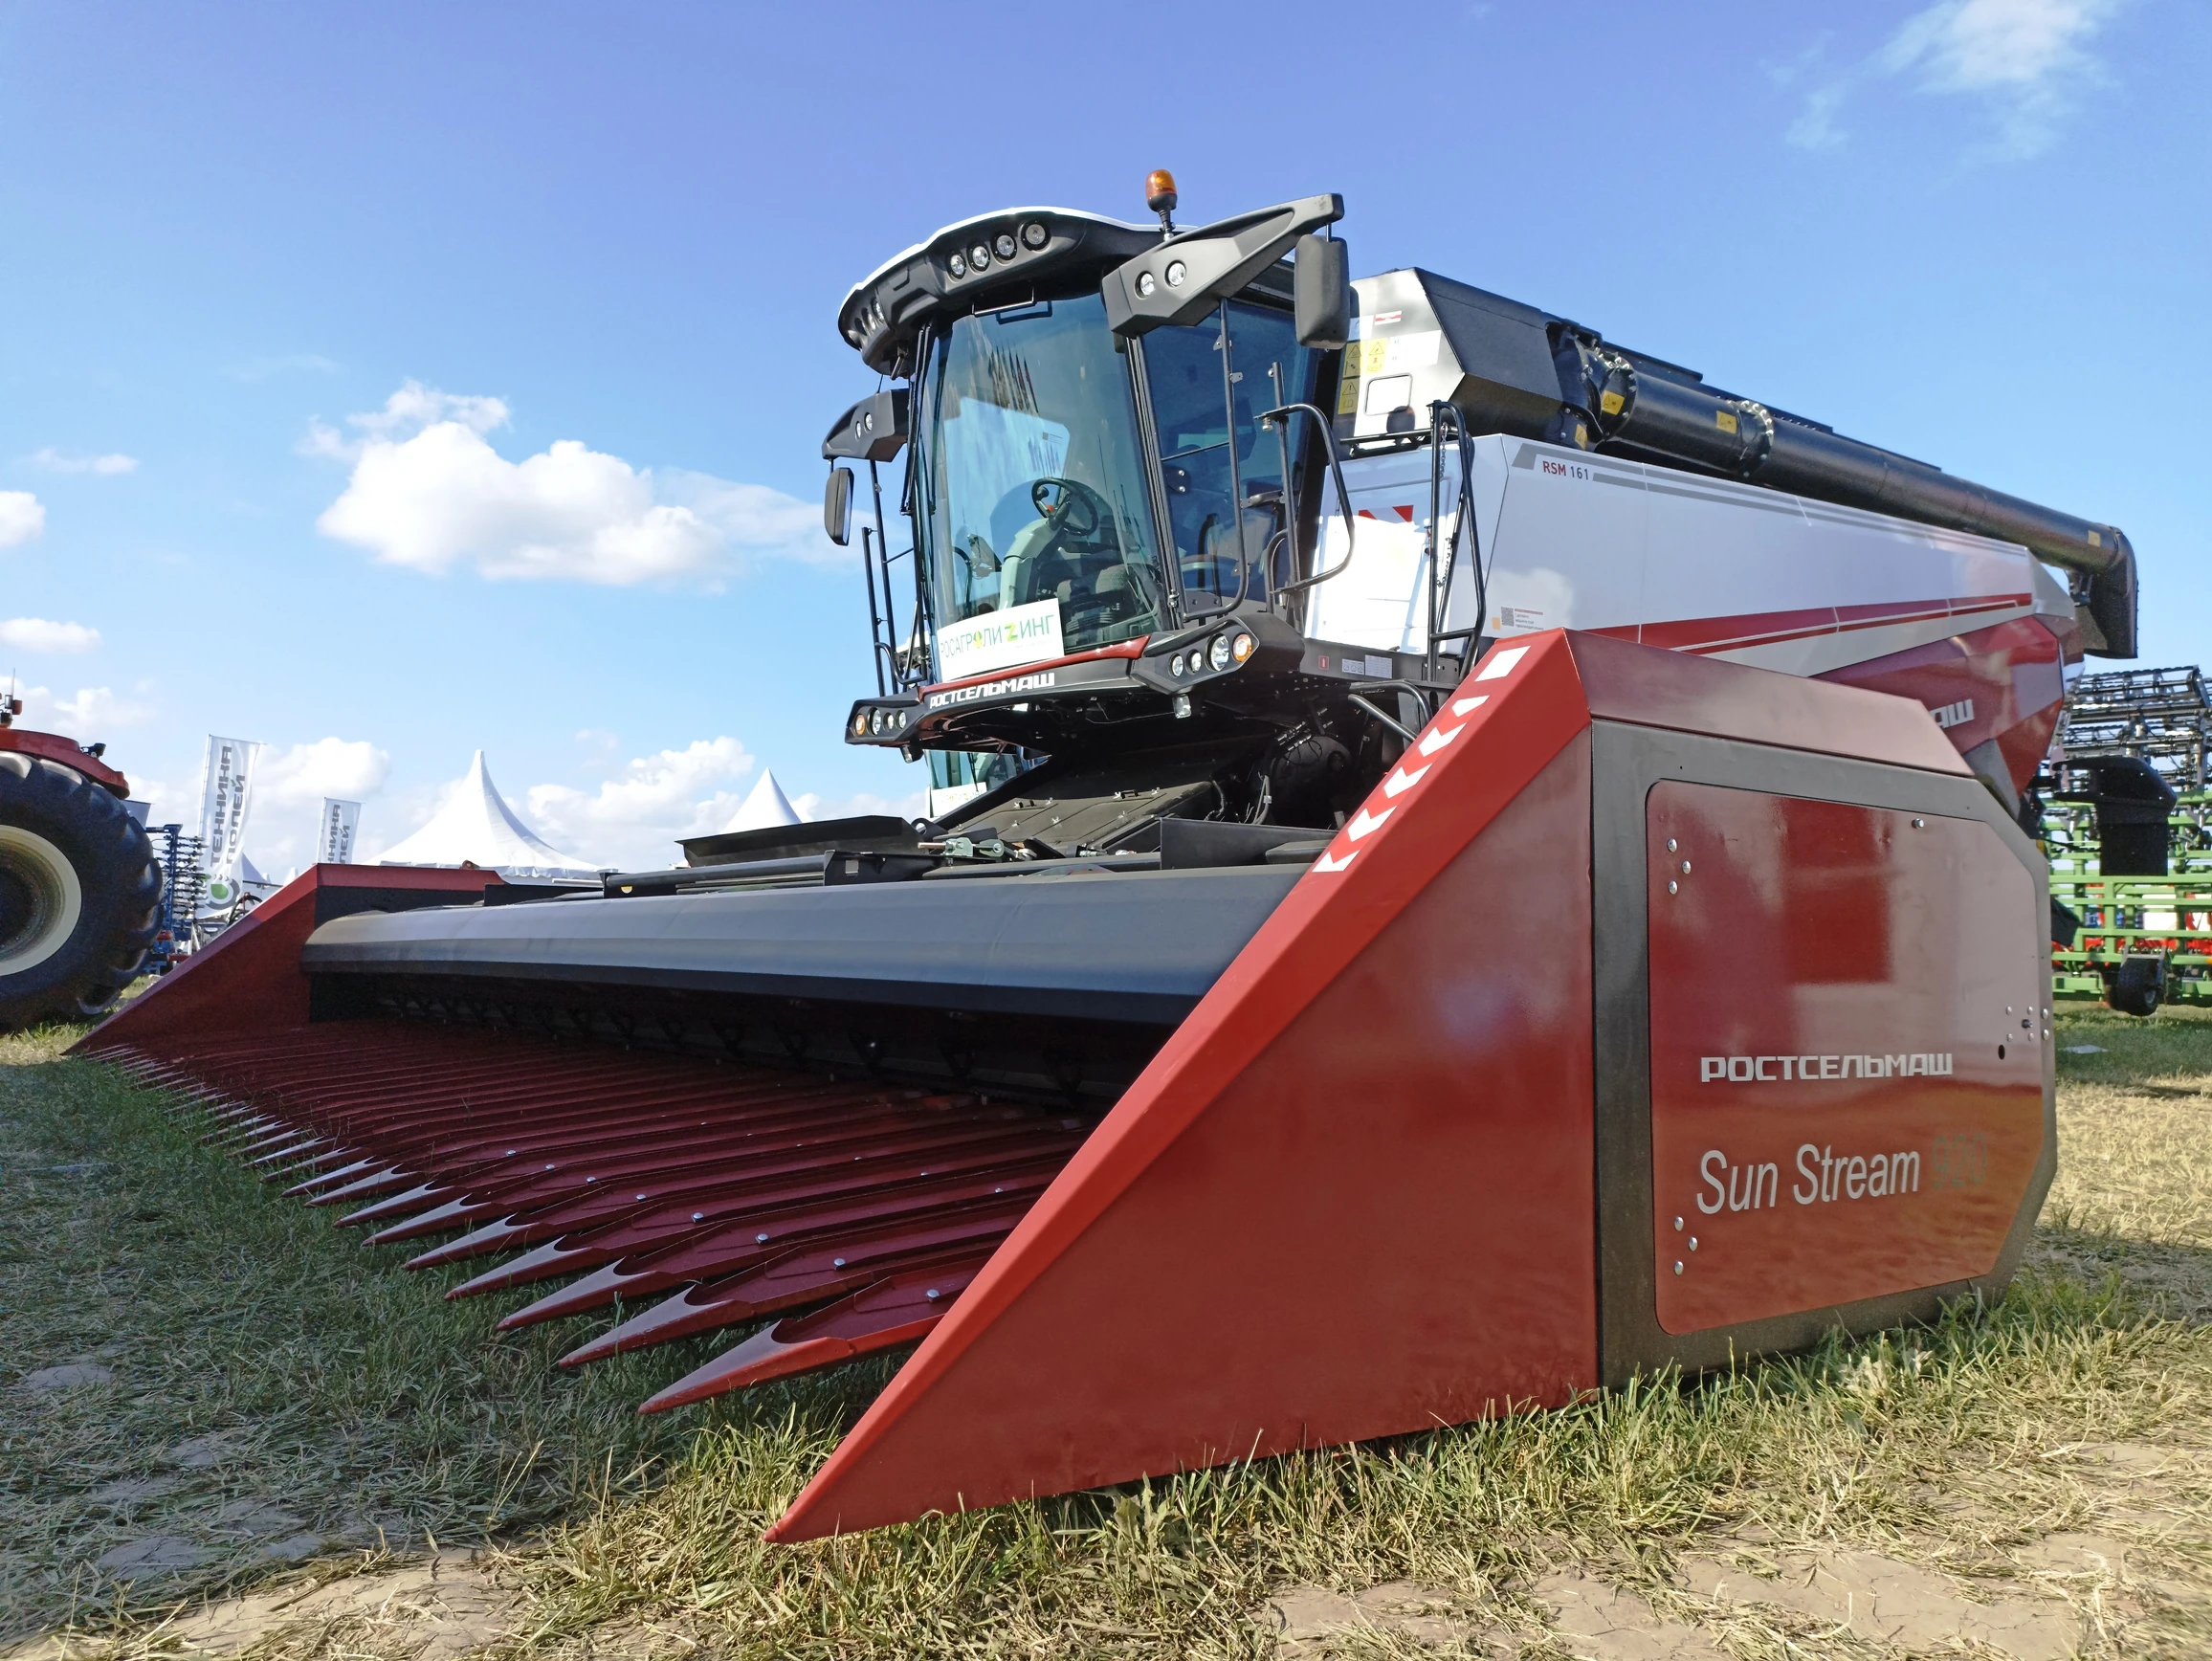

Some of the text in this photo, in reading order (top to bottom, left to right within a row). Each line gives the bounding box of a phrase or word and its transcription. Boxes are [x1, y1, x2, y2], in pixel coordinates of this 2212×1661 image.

[1542, 460, 1588, 480] RSM 161
[929, 672, 1055, 709] РОСТСЕЛЬМАШ
[226, 774, 246, 865] ПОЛЕЙ
[1700, 1053, 1953, 1083] РОСТСЕЛЬМАШ
[1696, 1149, 1779, 1215] Sun
[1793, 1143, 1920, 1206] Stream
